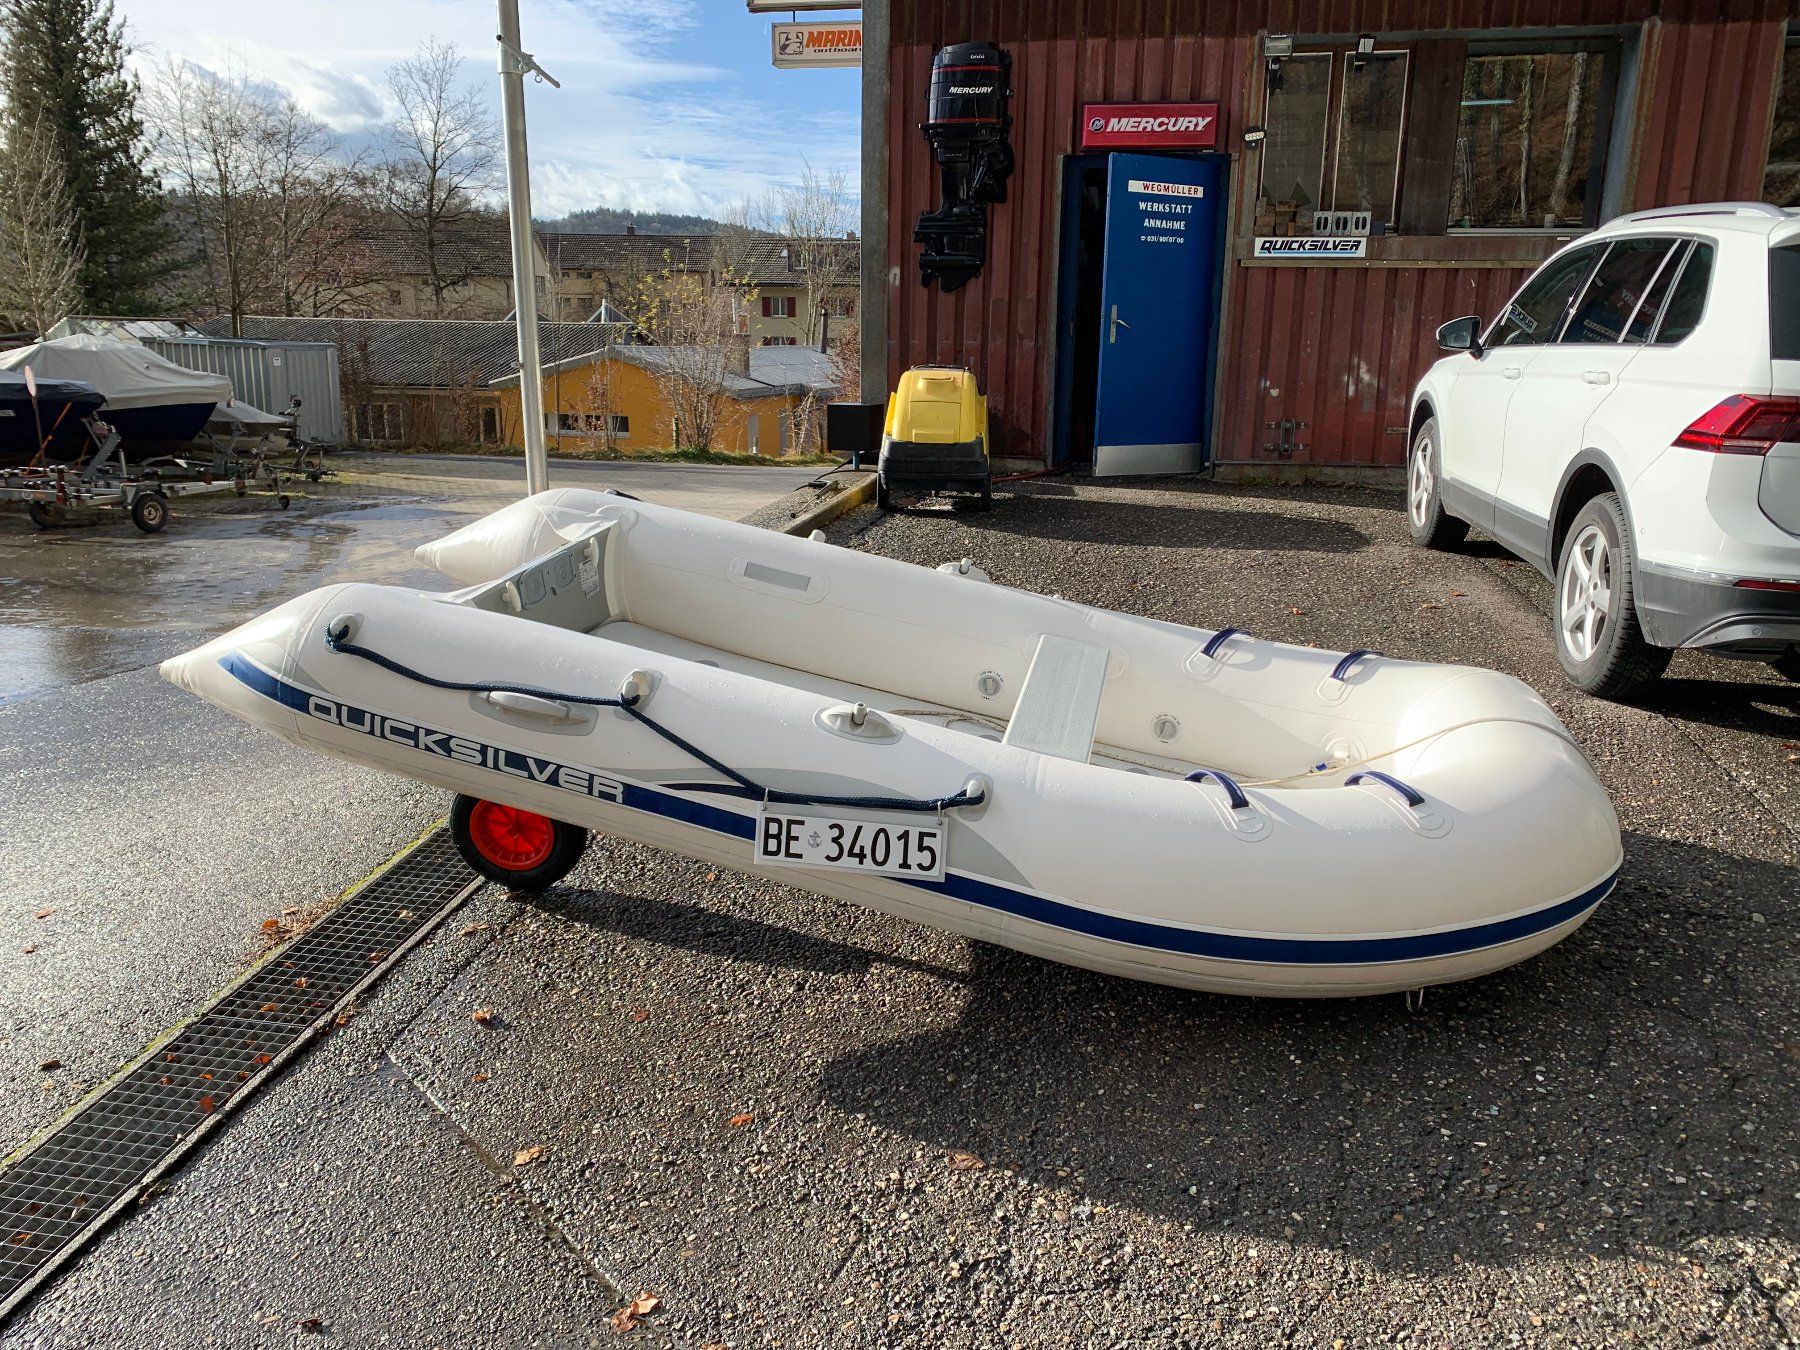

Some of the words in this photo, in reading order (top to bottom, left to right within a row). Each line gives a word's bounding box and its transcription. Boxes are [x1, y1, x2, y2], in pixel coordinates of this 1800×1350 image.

[948, 86, 993, 94] MERCURY
[1106, 117, 1213, 132] MERCURY
[1142, 182, 1200, 196] WEGMÜLLER
[1138, 201, 1193, 214] WERKSTATT
[1143, 218, 1186, 230] ANNAHME
[1260, 240, 1362, 254] QUICKSILVER
[307, 695, 624, 804] QUICKSILVER
[762, 816, 805, 859] BE
[823, 822, 938, 872] 34015
